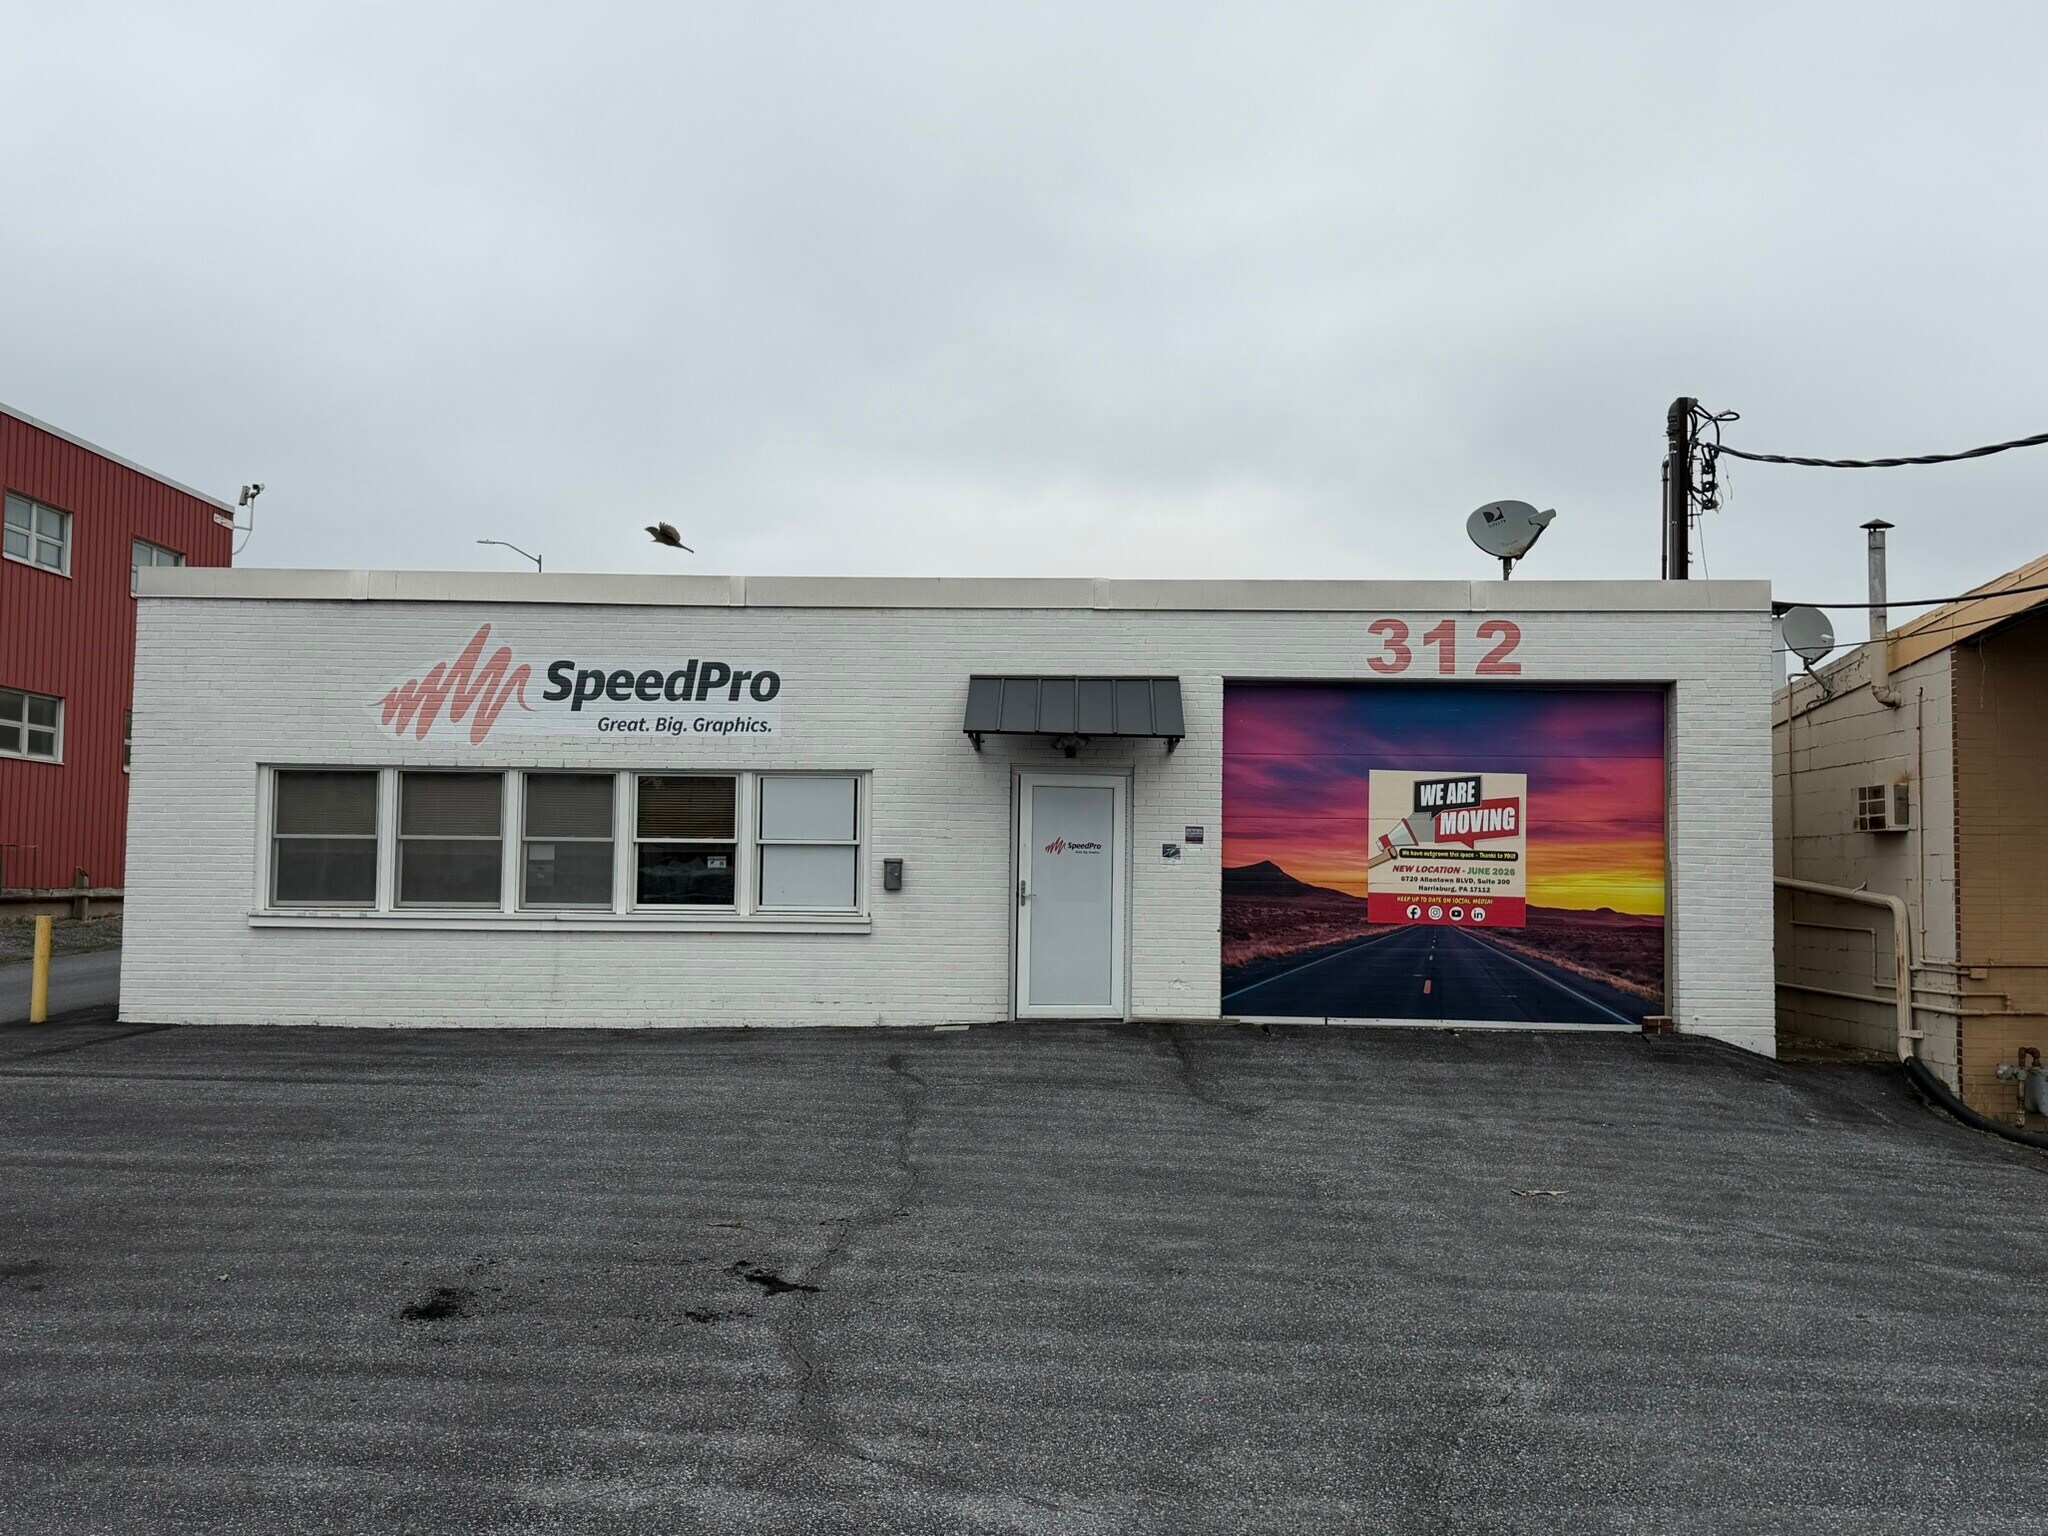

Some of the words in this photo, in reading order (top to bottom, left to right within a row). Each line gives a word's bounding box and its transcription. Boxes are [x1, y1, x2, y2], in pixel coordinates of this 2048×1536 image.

[1367, 618, 1522, 675] 312
[542, 659, 781, 712] SpeedPro
[598, 716, 650, 733] Great.
[654, 716, 687, 736] Big.
[692, 716, 772, 736] Graphics.
[1420, 784, 1444, 806] WE
[1446, 781, 1476, 804] ARE
[1440, 807, 1516, 835] MOVING
[1068, 842, 1101, 850] SpeedPro
[1392, 865, 1415, 873] NEW
[1416, 866, 1460, 874] LOCATION
